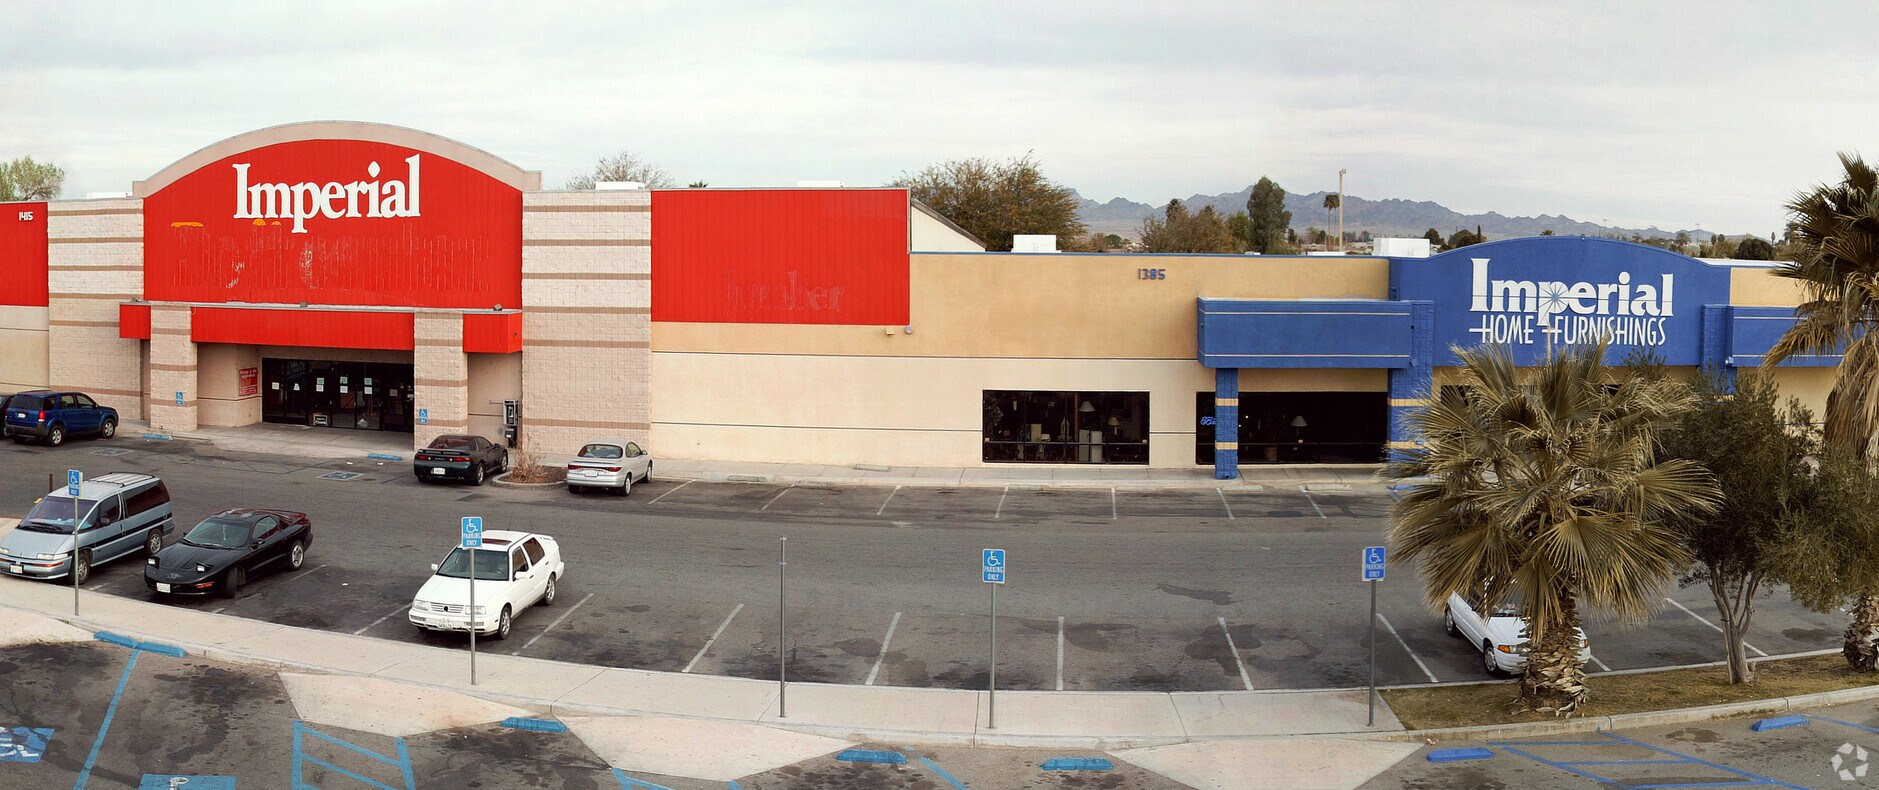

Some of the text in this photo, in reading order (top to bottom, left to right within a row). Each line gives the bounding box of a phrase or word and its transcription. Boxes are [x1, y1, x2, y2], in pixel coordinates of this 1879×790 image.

[232, 153, 421, 233] Imperial
[1138, 268, 1166, 280] 1385
[1470, 257, 1674, 327] Imperial
[1469, 314, 1667, 347] HOME FURNISHINGS
[983, 565, 1004, 573] PARKING
